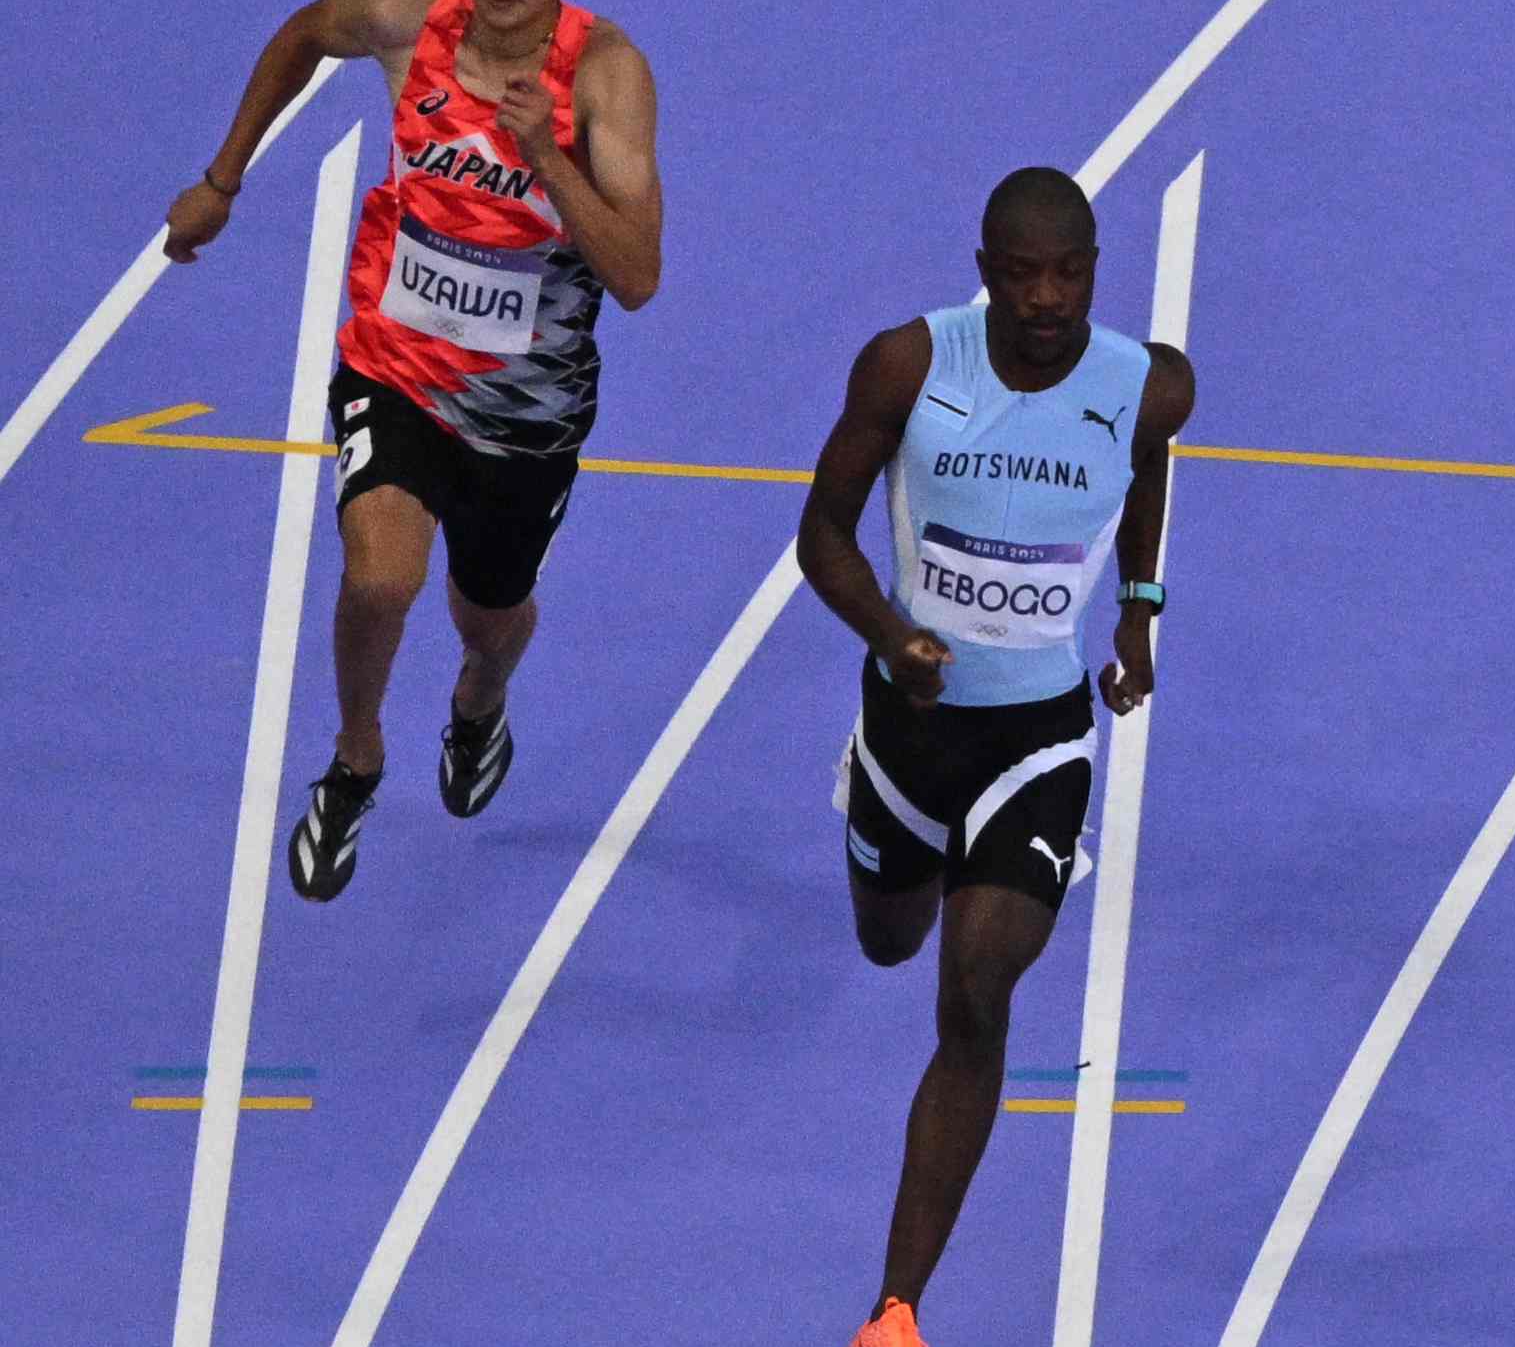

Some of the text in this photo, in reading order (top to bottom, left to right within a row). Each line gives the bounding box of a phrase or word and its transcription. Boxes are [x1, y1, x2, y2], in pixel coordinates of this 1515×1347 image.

[407, 141, 535, 200] JAPAN
[401, 255, 524, 321] UZAWA
[933, 452, 1088, 491] BOTSWANA
[964, 539, 1044, 559] PARIS 2024
[920, 558, 1071, 616] TEBOGO
